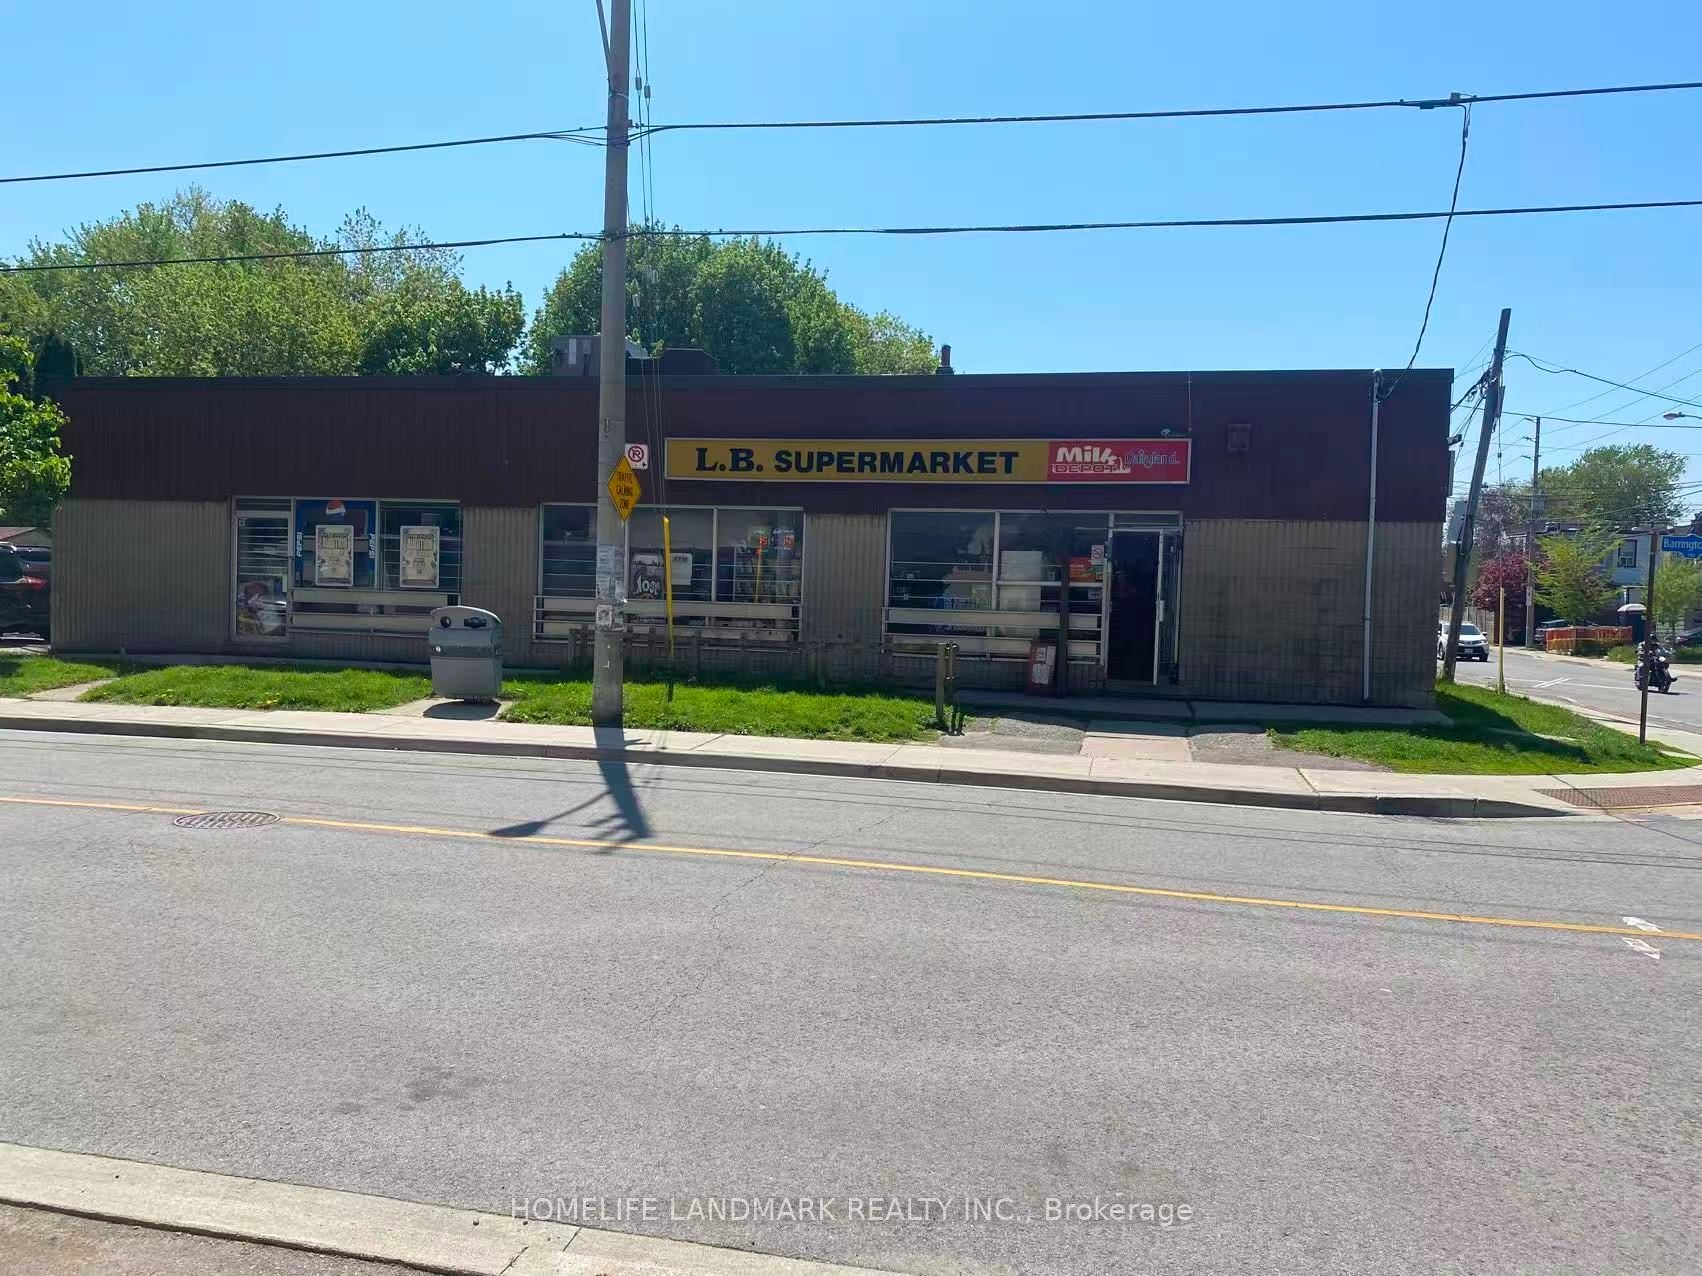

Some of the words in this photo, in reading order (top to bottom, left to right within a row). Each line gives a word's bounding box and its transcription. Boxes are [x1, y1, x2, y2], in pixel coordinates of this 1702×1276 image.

[695, 448, 764, 472] L.B.
[774, 449, 1020, 475] SUPERMARKET
[1055, 445, 1118, 465] Milk
[368, 533, 376, 559] PEPSI
